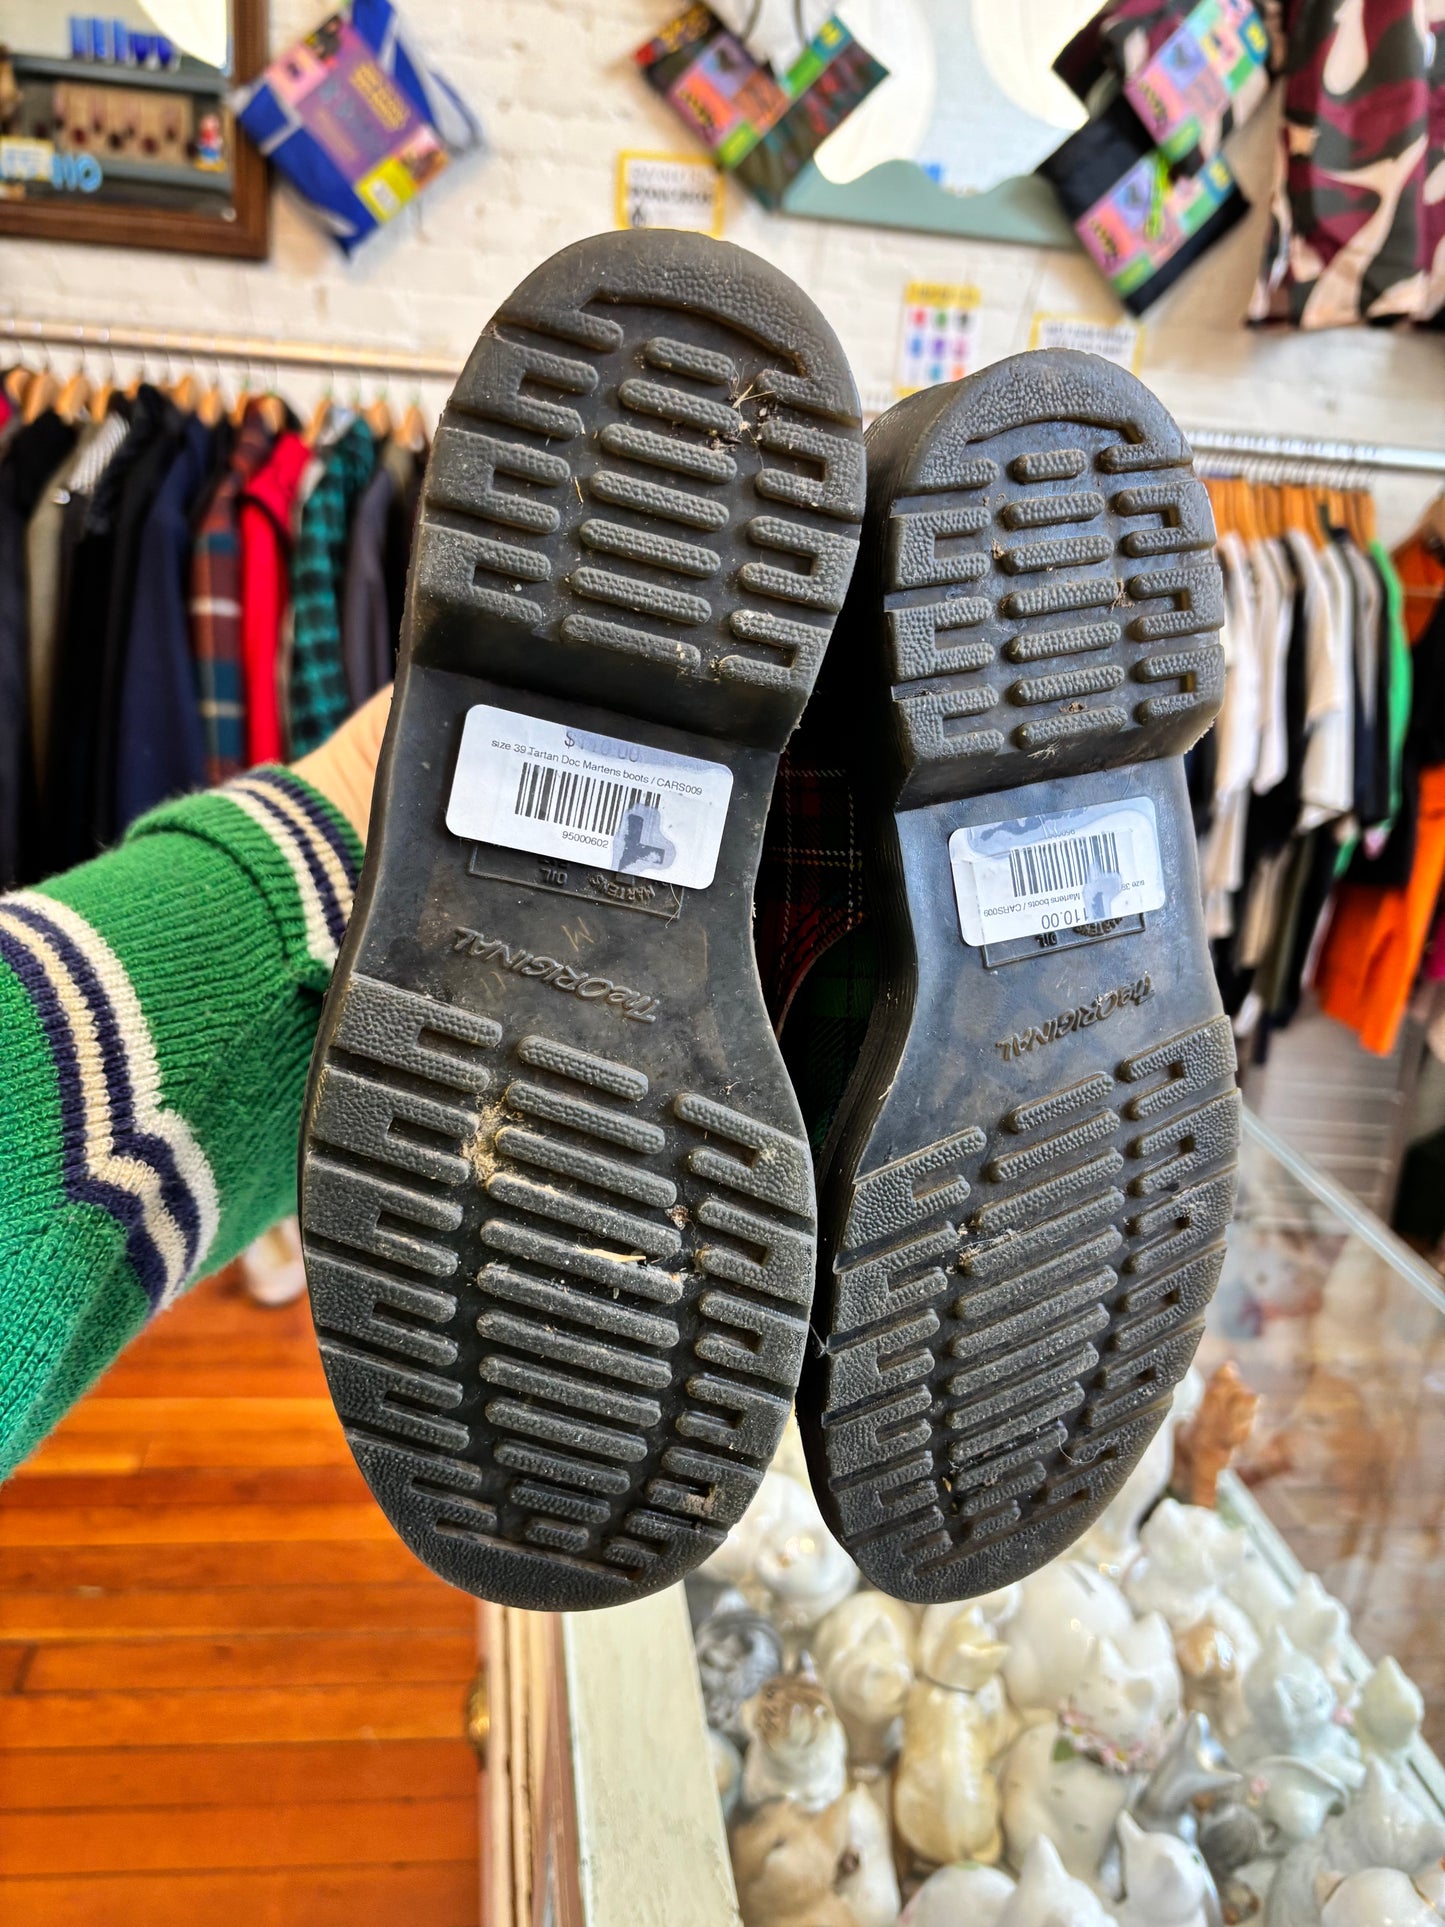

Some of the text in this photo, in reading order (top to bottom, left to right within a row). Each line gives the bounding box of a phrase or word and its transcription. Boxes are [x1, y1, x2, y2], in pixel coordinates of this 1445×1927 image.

[491, 738, 512, 752] size
[513, 742, 527, 755] 39
[528, 746, 559, 762] Tartan
[561, 753, 581, 768] Doc
[583, 759, 622, 778] Martens
[623, 768, 649, 784] boots
[656, 777, 703, 796] CARS009
[561, 830, 610, 849] 95000602
[1027, 898, 1049, 908] boots
[1049, 892, 1081, 906] Martens
[983, 903, 1022, 918] CARS009
